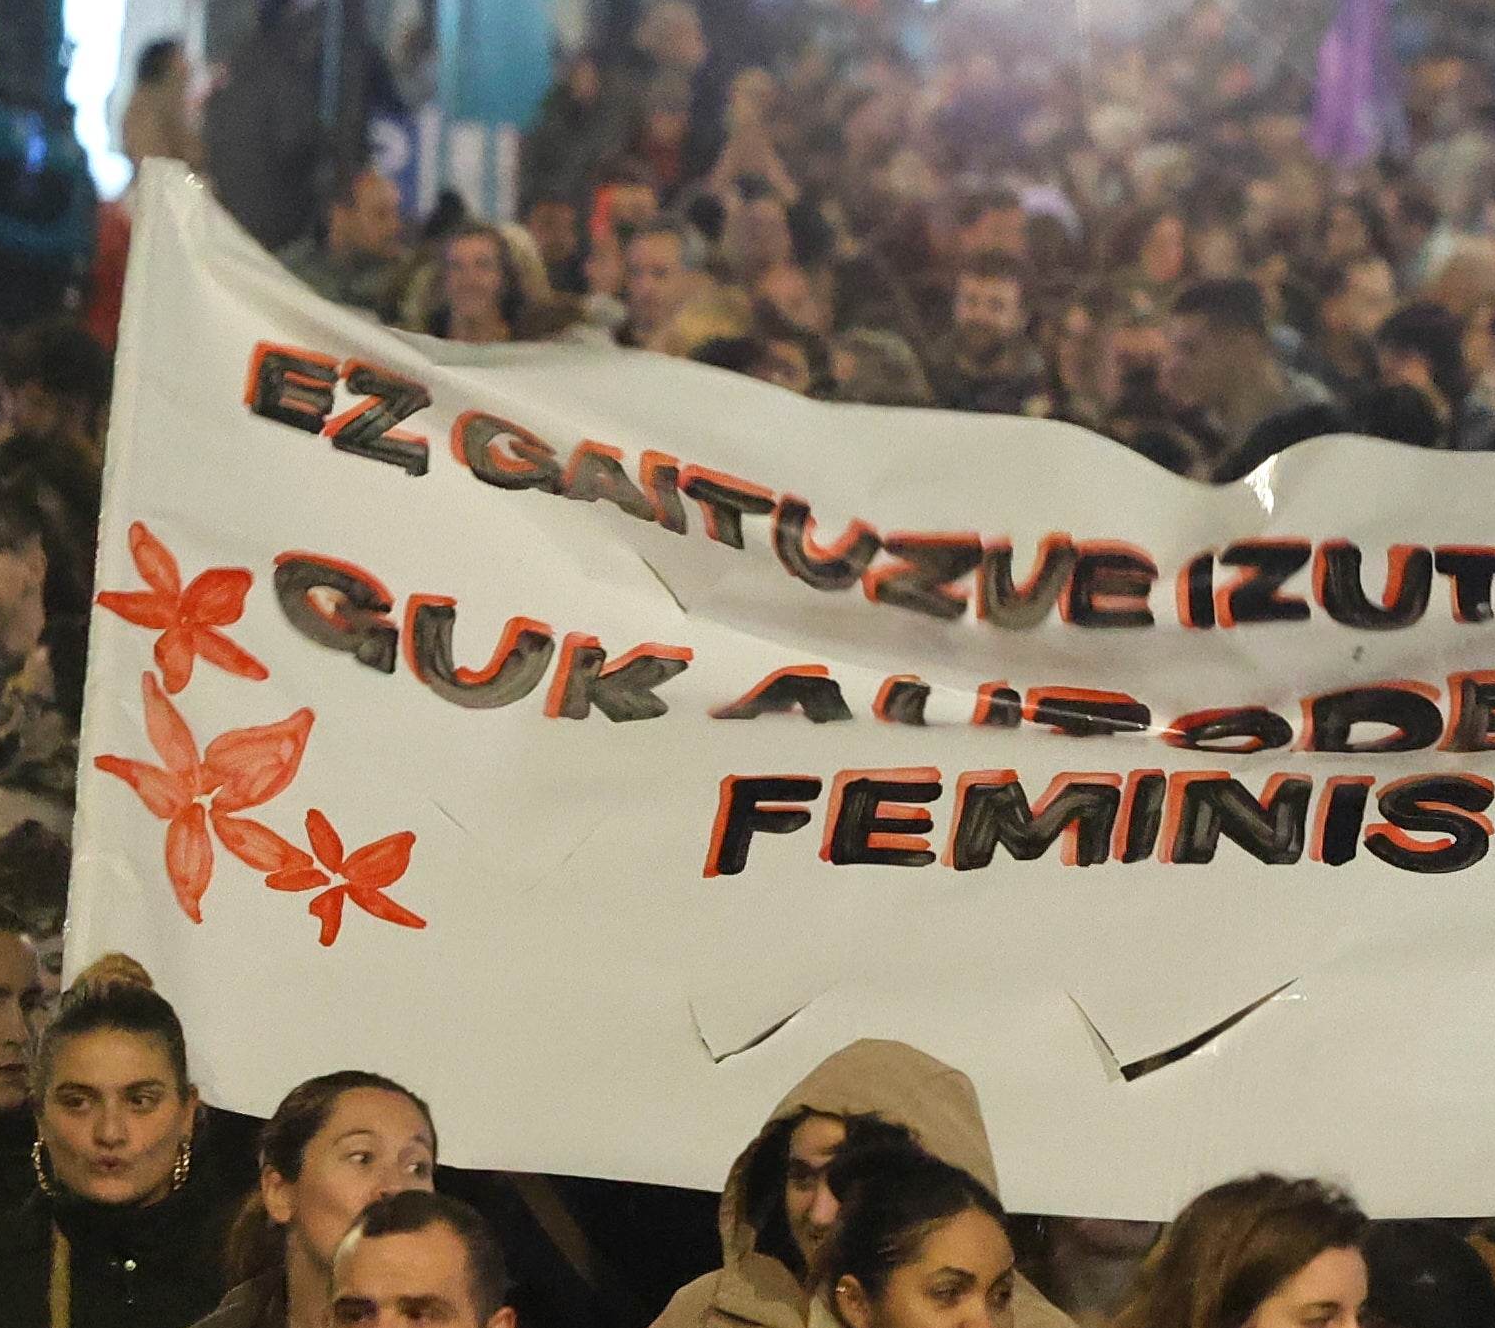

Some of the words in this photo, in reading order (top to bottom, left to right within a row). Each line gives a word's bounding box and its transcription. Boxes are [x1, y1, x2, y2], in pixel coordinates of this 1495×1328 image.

[244, 340, 430, 477] EZ
[450, 409, 1159, 631] GAITUZUE
[273, 549, 695, 724] GUK
